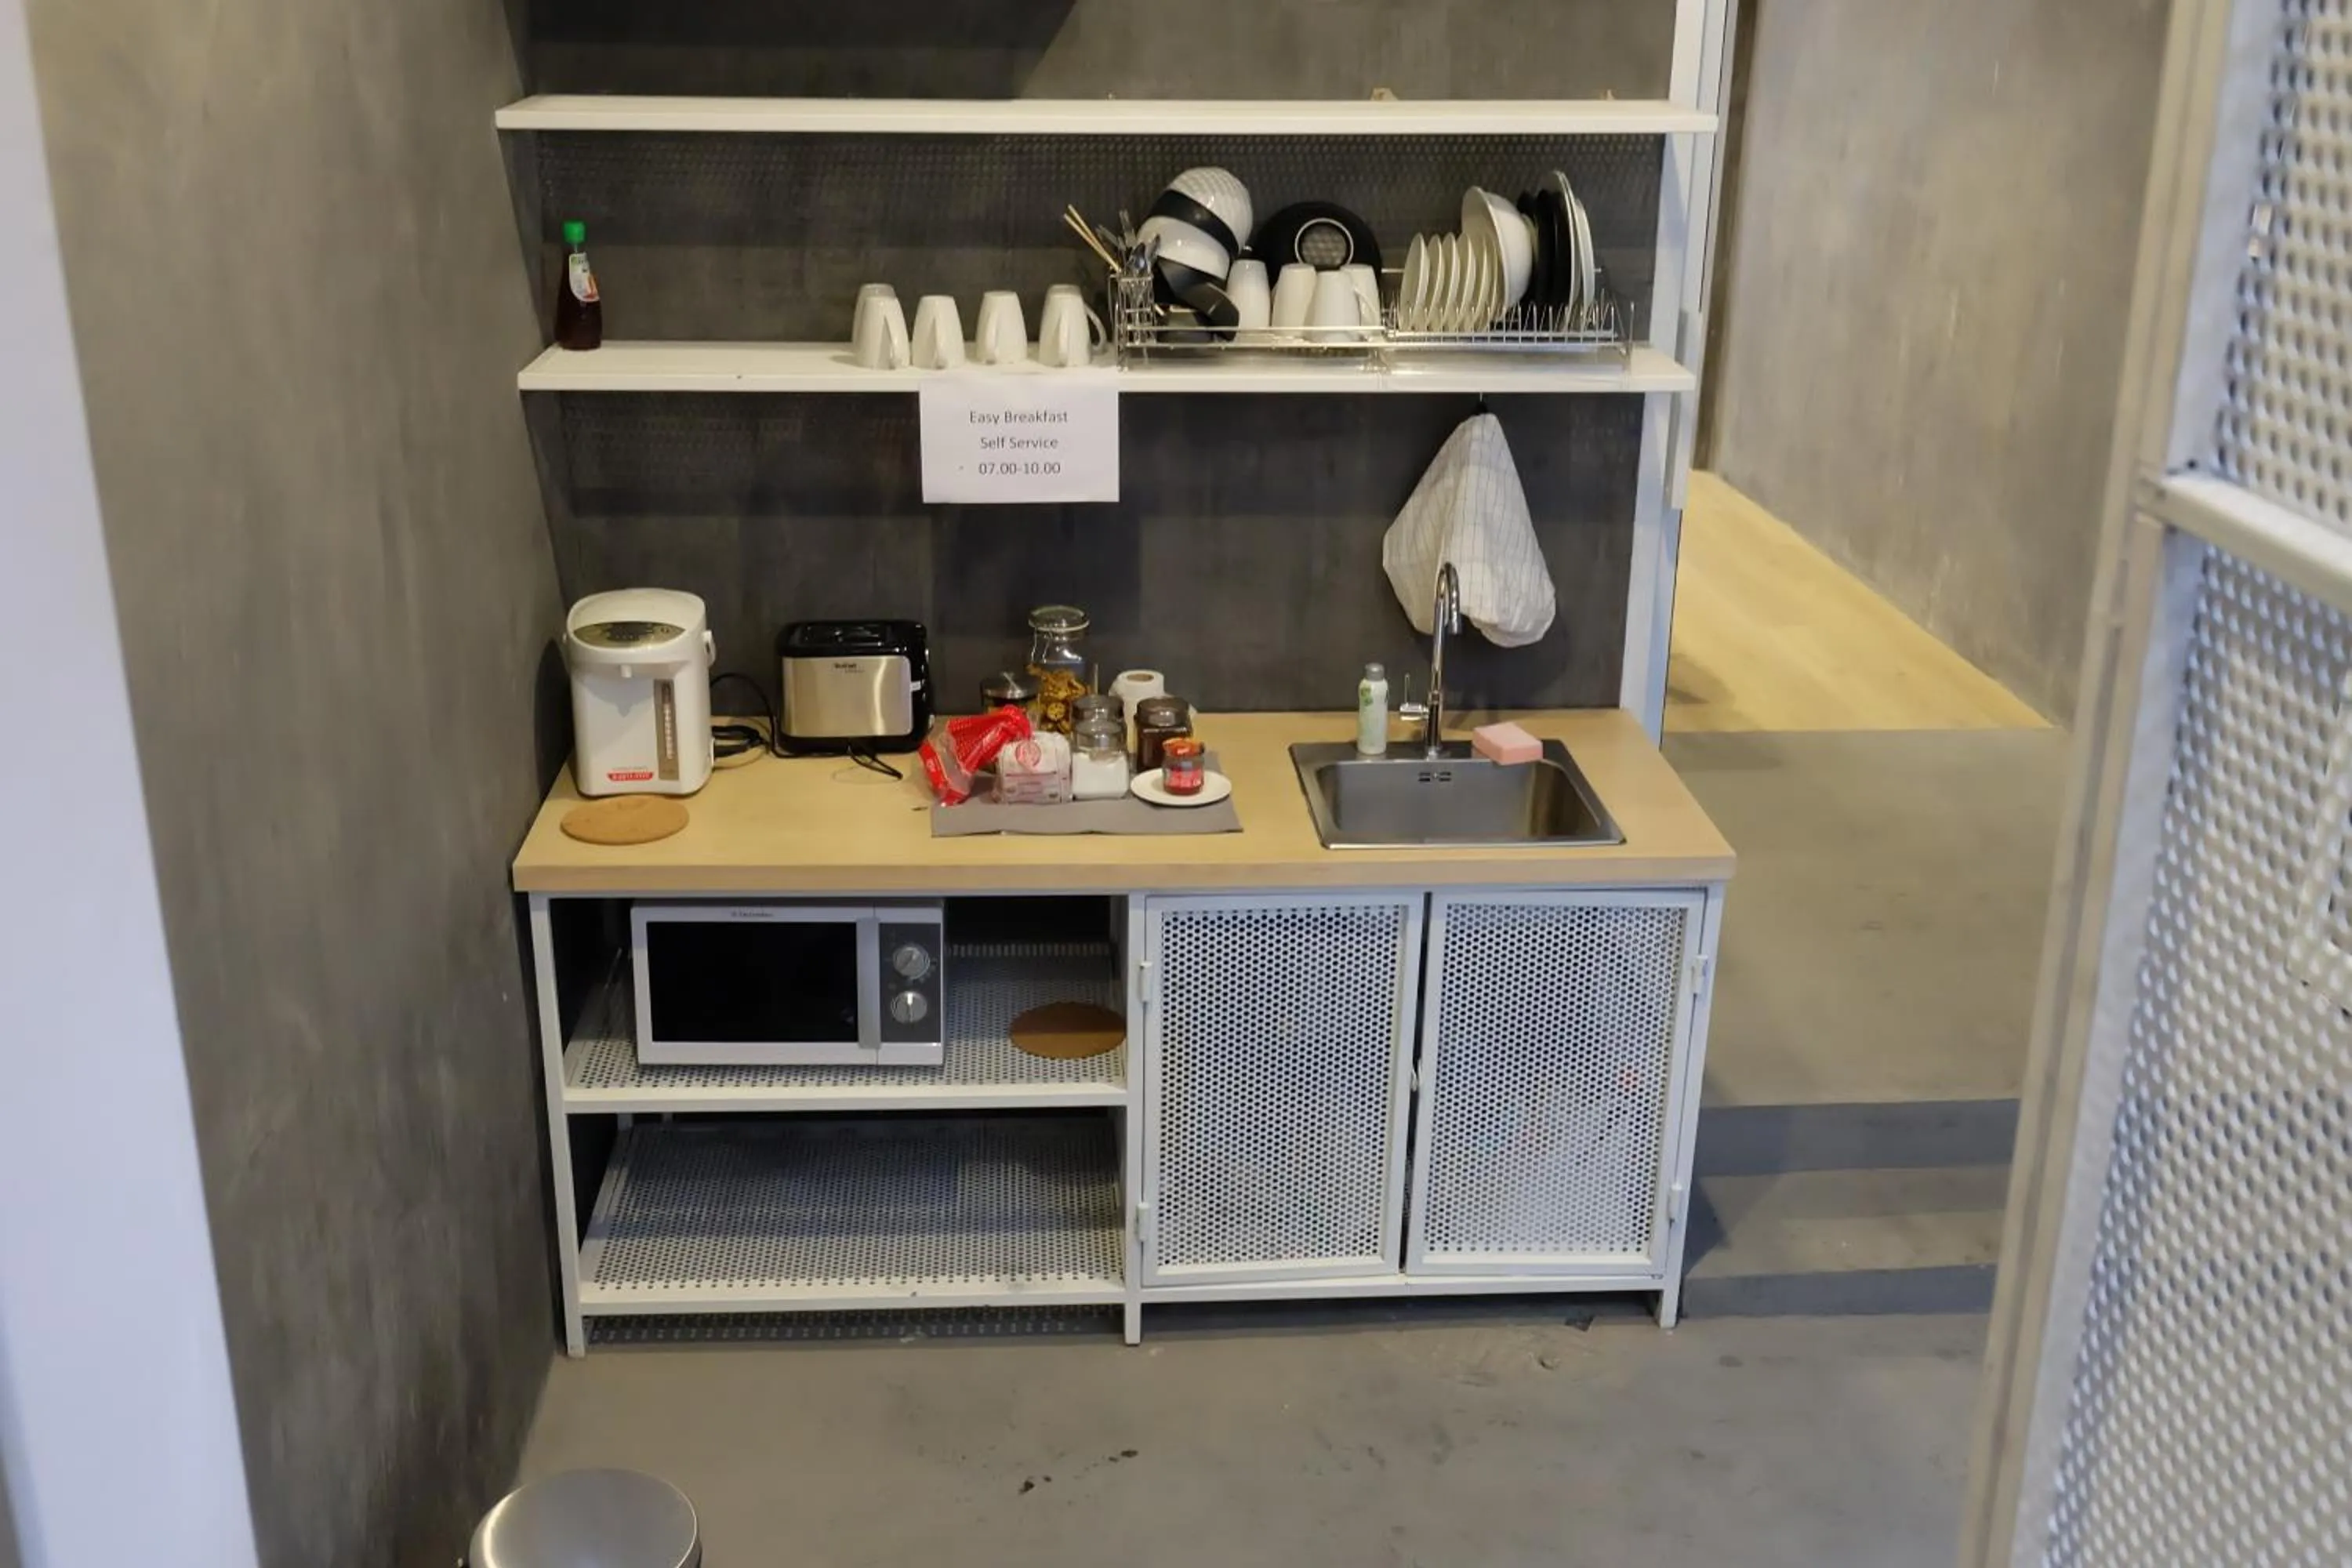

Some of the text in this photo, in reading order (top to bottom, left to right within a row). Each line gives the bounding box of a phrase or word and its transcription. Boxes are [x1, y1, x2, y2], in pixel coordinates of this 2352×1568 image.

[969, 410, 1068, 425] Easy Breakfast
[980, 436, 1058, 450] Self Service
[978, 462, 1061, 475] 07.00-10.00
